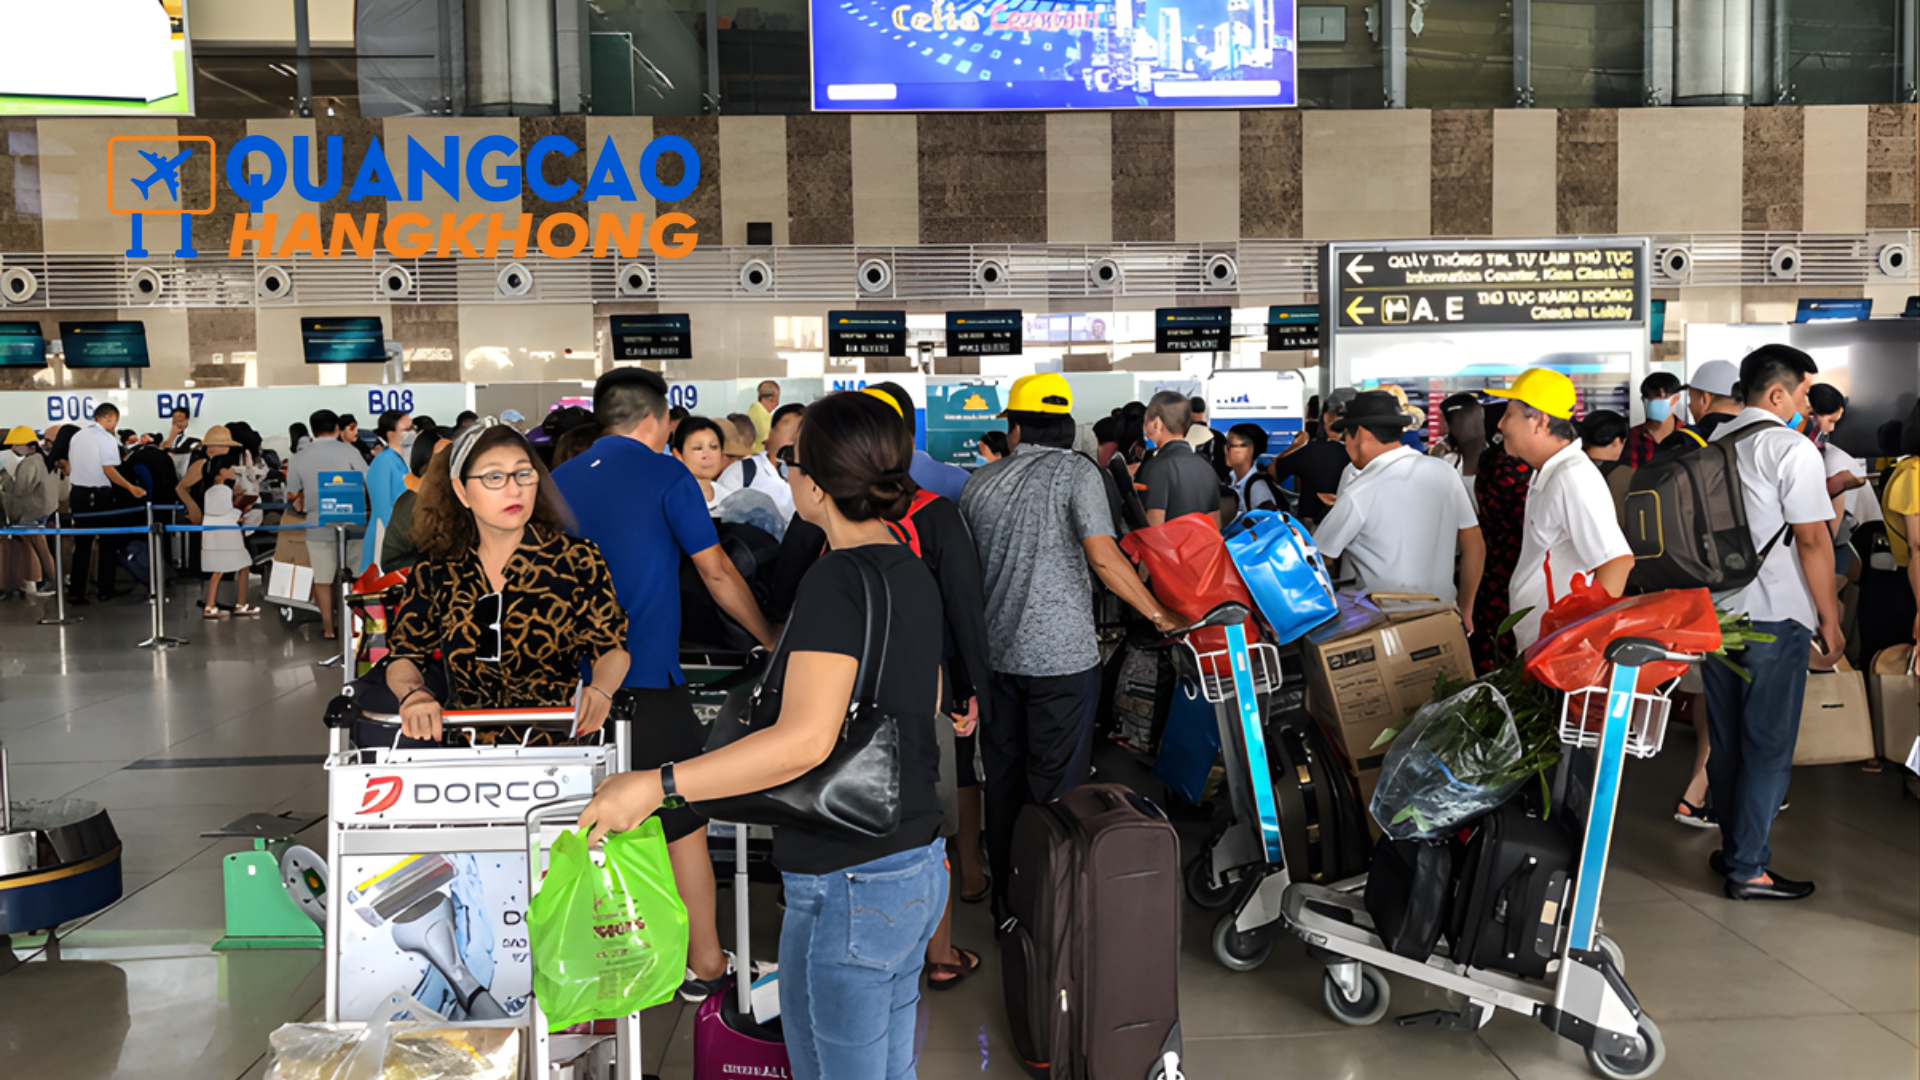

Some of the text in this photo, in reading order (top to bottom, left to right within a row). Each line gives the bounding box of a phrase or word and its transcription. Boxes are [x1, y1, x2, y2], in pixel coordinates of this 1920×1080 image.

[1446, 296, 1465, 321] E
[47, 396, 95, 421] B06
[368, 389, 414, 415] B08
[669, 384, 698, 410] 09
[414, 780, 560, 808] DORCO
